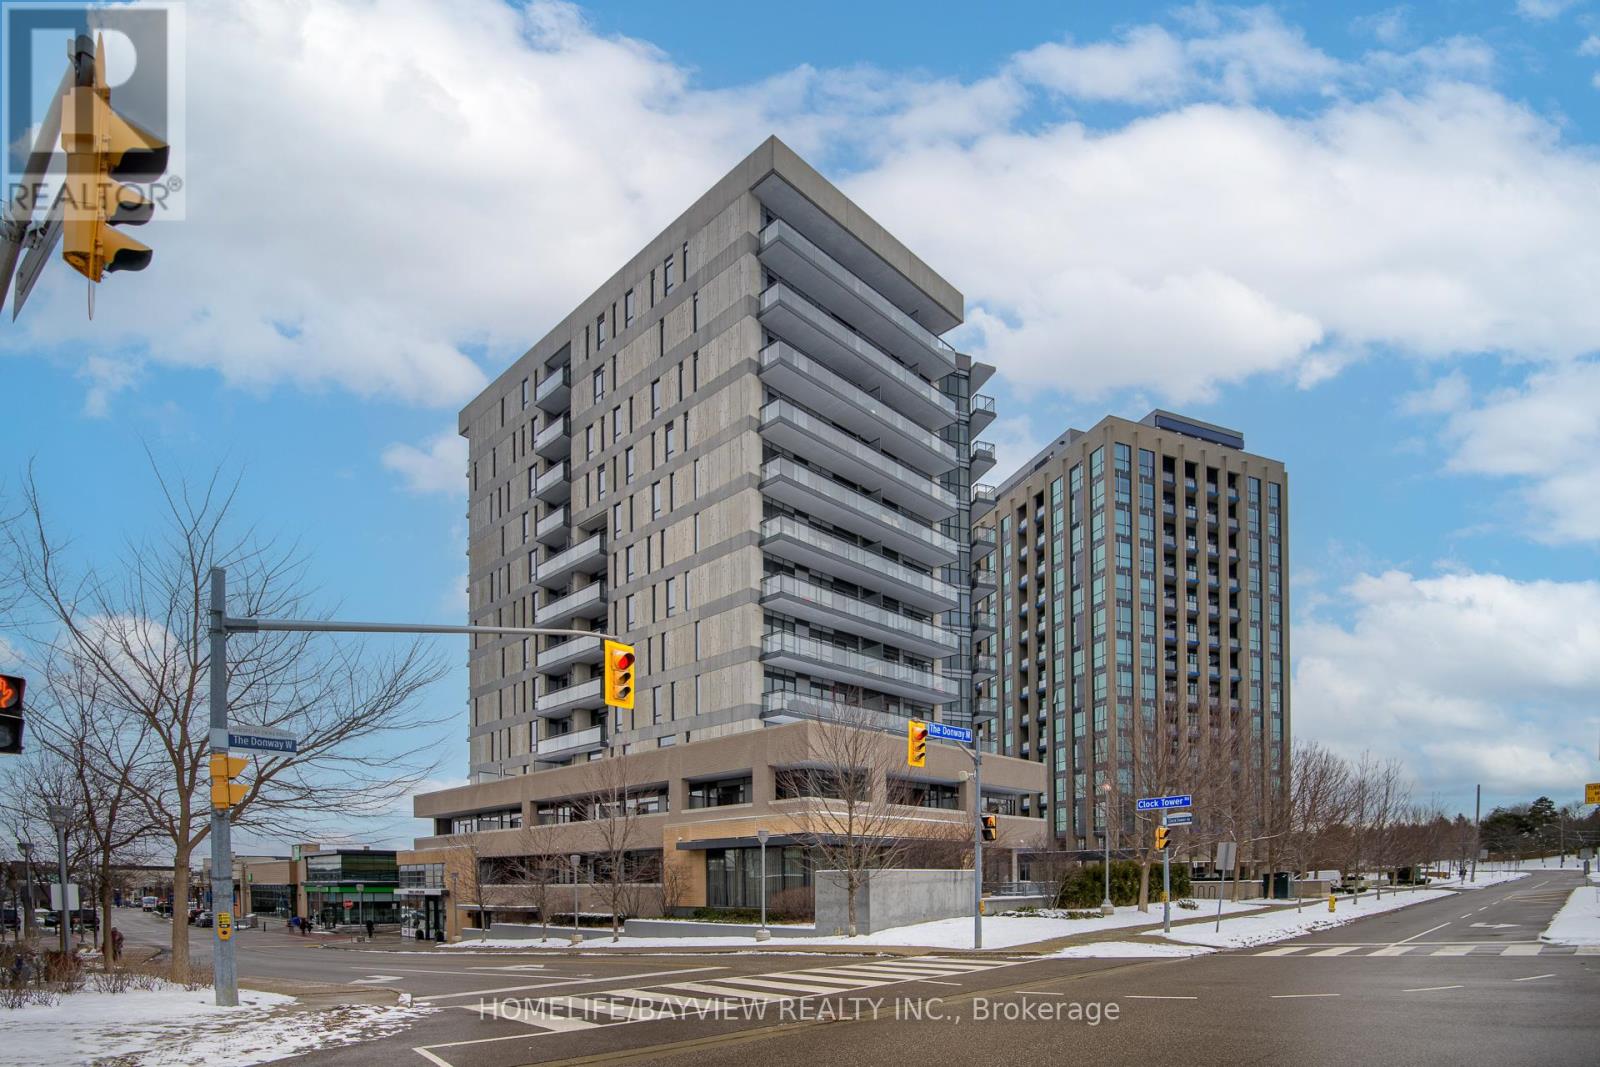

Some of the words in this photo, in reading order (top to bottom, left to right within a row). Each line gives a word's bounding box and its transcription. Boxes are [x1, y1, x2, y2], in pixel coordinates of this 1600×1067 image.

[930, 724, 941, 734] The
[943, 726, 965, 740] Donway
[233, 735, 249, 745] The
[251, 737, 284, 750] Donway
[285, 741, 293, 749] W
[1138, 800, 1159, 809] Clock
[1161, 798, 1183, 807] Tower
